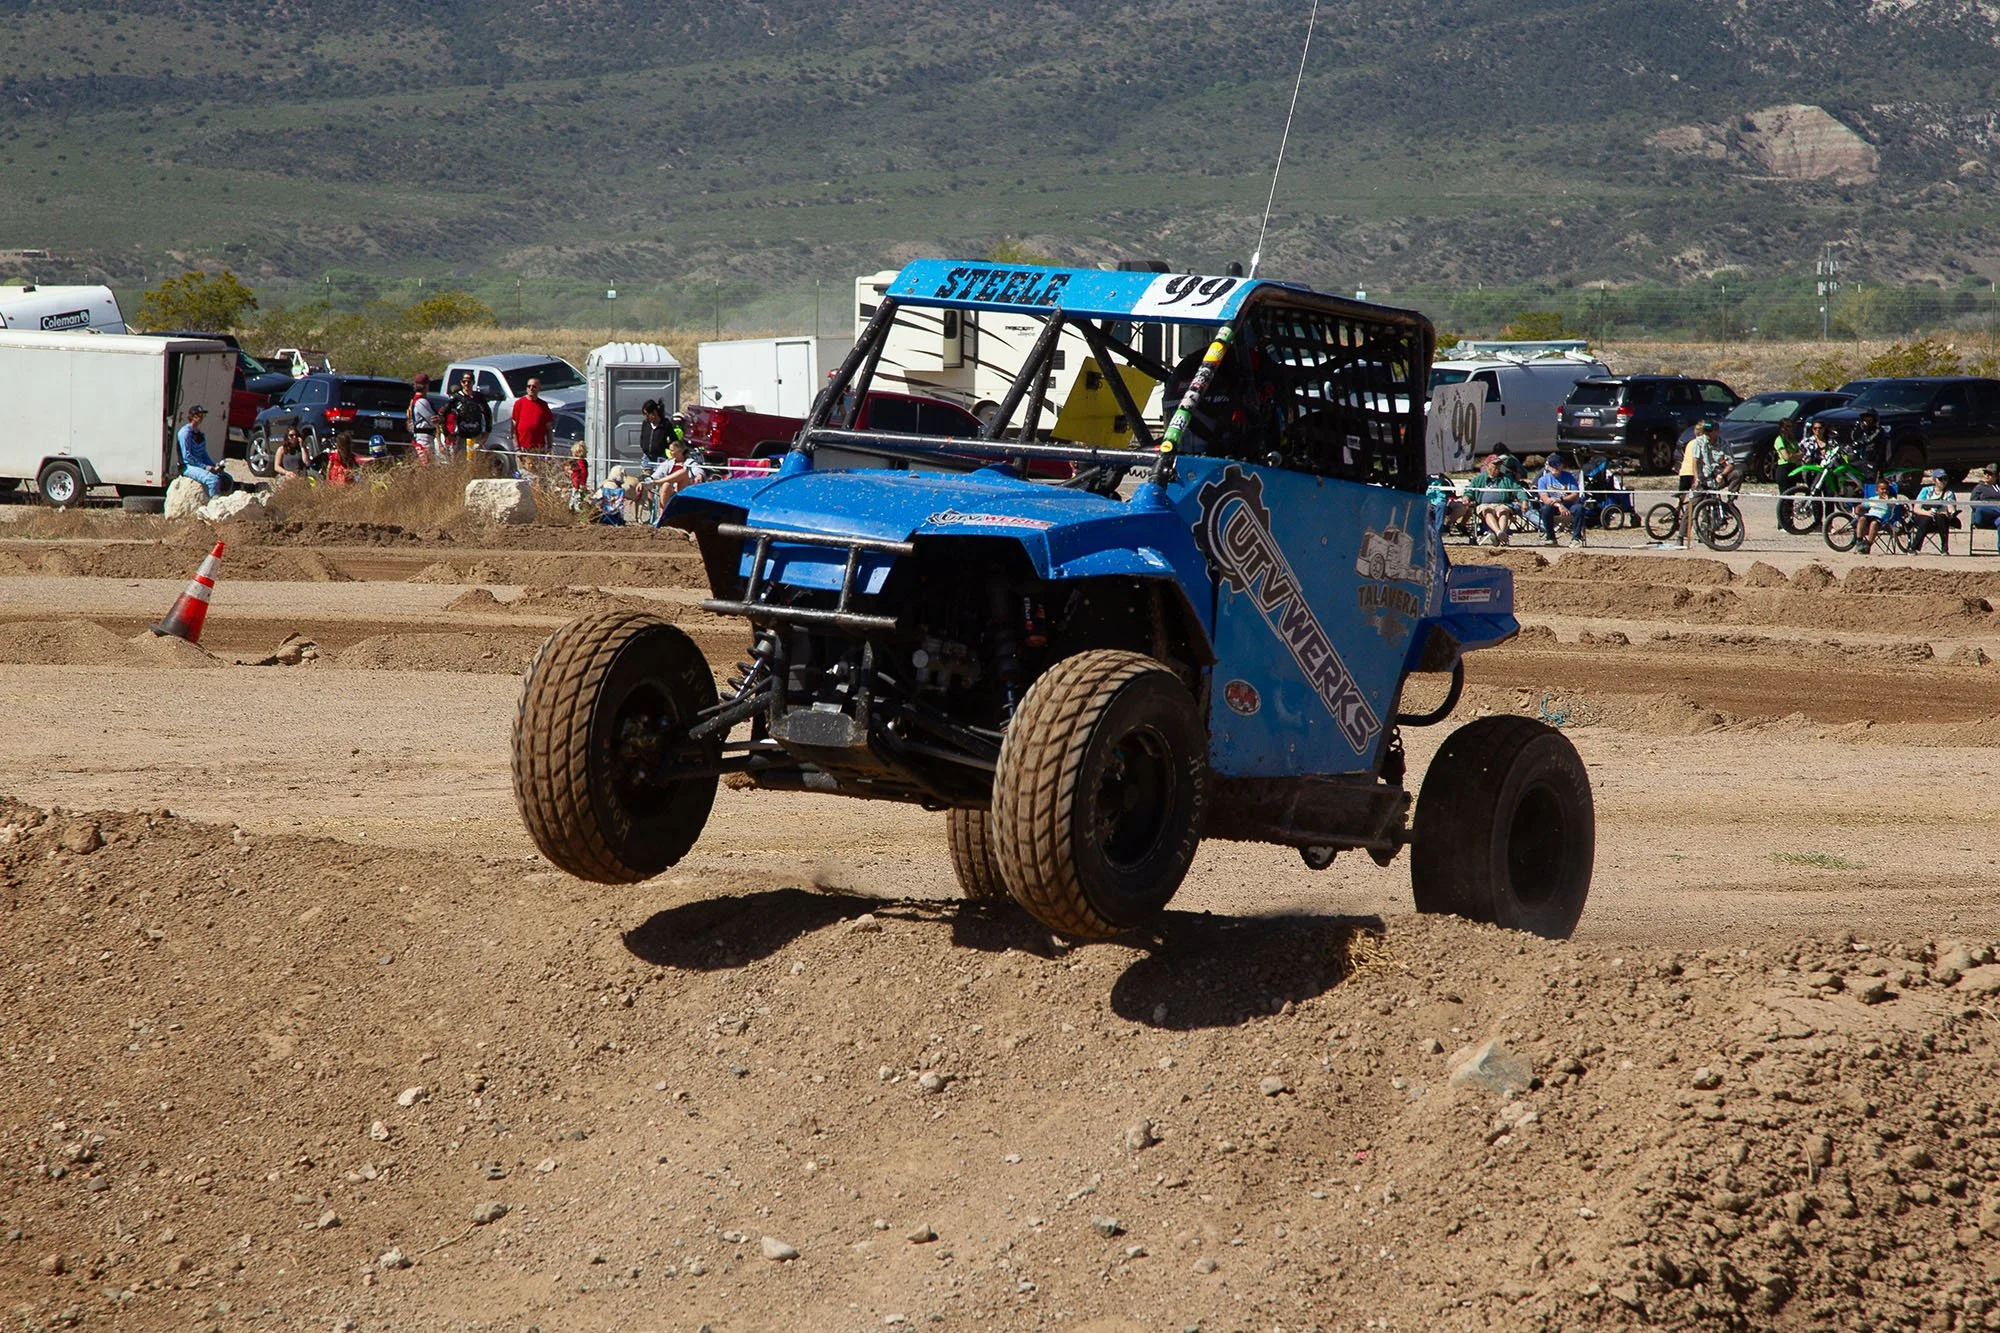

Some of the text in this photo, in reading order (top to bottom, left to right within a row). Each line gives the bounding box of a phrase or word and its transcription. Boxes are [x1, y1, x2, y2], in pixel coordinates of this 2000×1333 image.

[935, 266, 1072, 306] STEELE
[1157, 275, 1238, 307] 99
[42, 314, 80, 330] Coleman
[1357, 583, 1419, 619] TALAVERA
